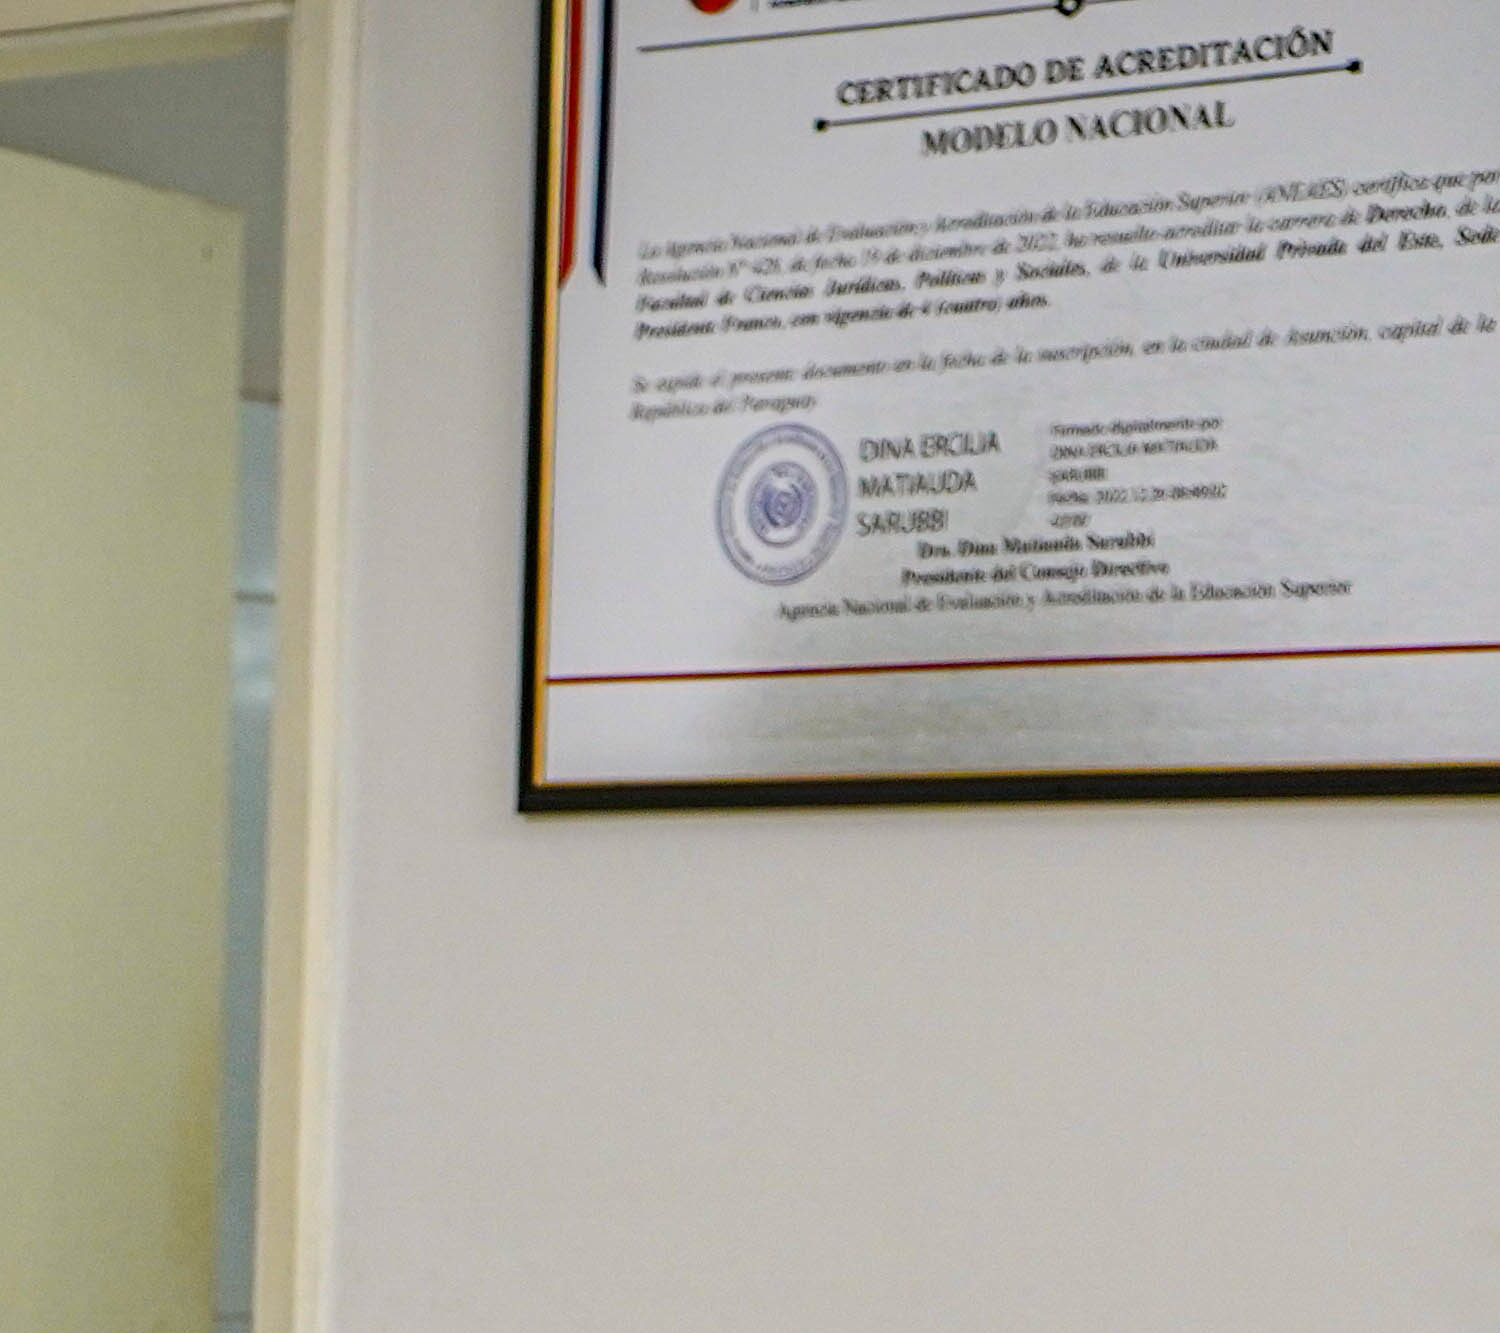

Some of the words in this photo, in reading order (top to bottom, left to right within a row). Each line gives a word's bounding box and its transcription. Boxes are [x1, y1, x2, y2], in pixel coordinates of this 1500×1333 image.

[836, 65, 1036, 106] CERTIFICADO
[1045, 56, 1085, 85] DE
[1093, 25, 1335, 79] ACREDITACIÓN
[920, 118, 1058, 157] MODELO
[1066, 100, 1236, 143] NACIONAL
[859, 436, 917, 463] DINA
[919, 431, 1002, 459] ERCILIA
[858, 468, 978, 499] MATIAUDA
[856, 507, 949, 538] SARUBBI
